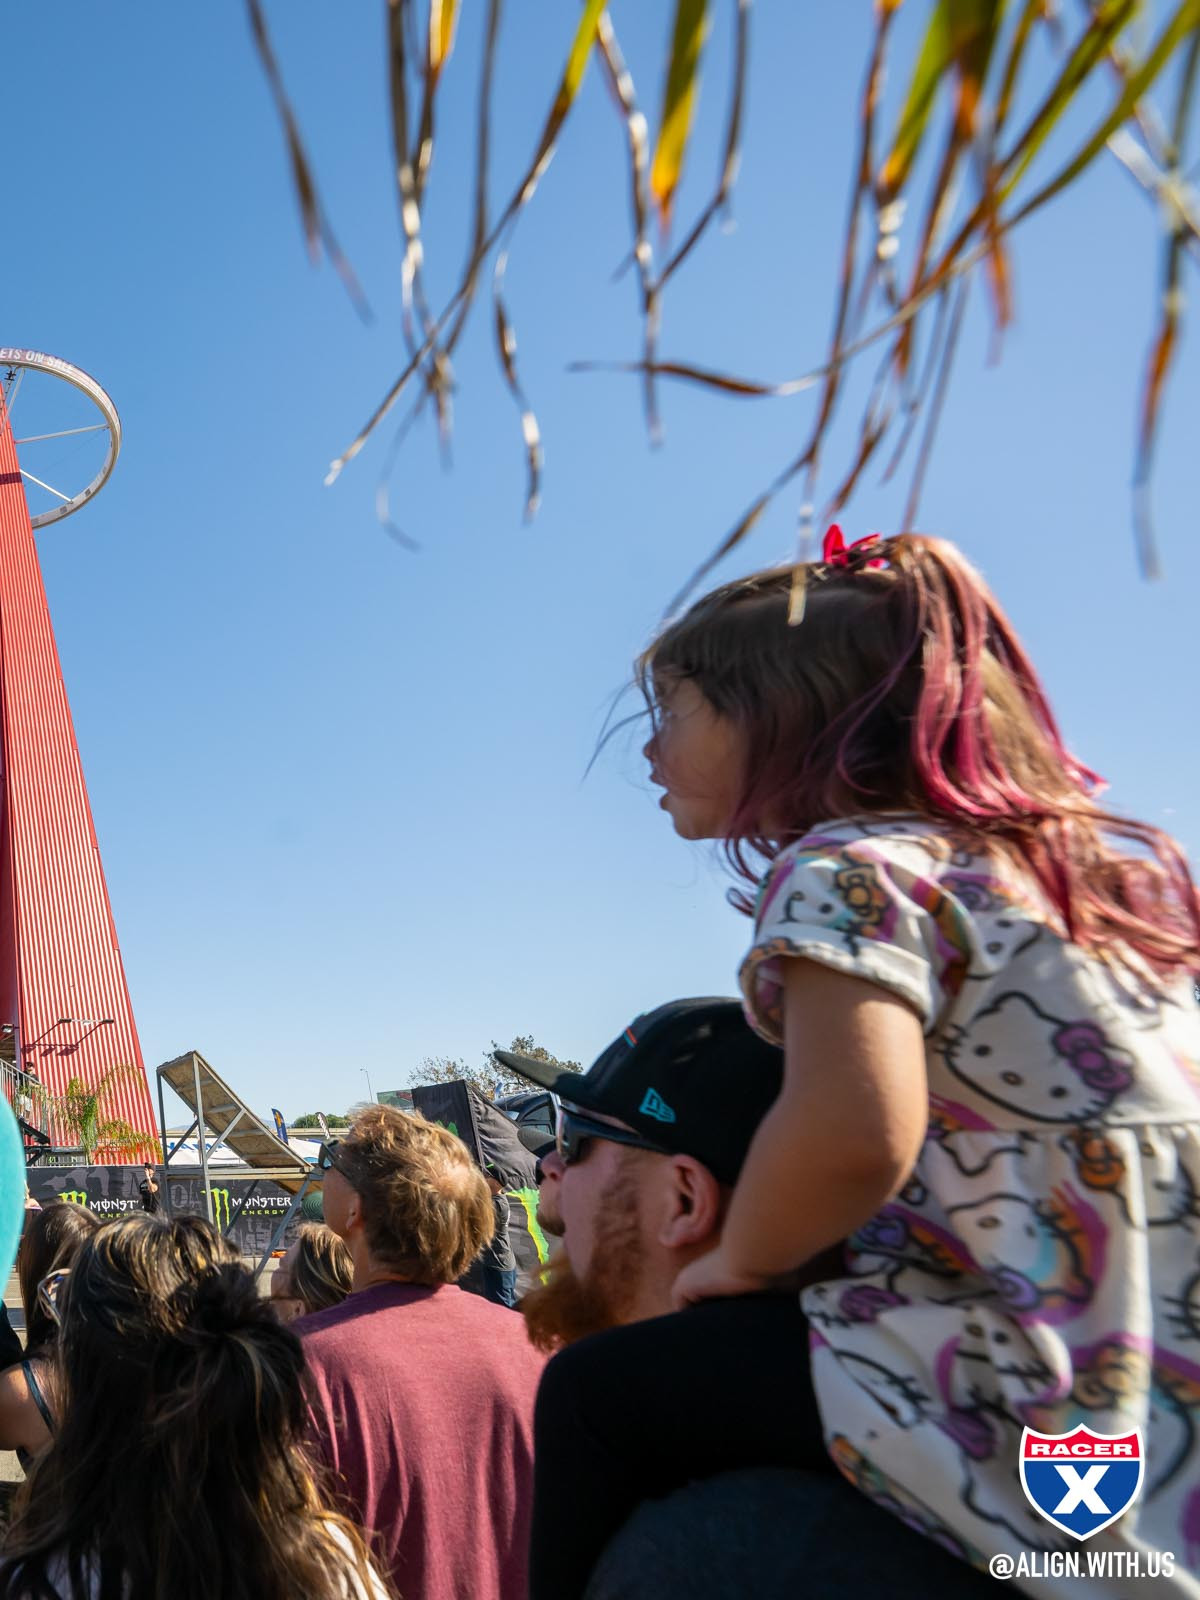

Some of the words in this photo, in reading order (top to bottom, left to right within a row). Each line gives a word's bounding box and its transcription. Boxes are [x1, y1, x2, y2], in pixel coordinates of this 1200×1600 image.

[26, 349, 44, 363] ON
[90, 1198, 144, 1212] MONST
[232, 1196, 293, 1209] MONSTER
